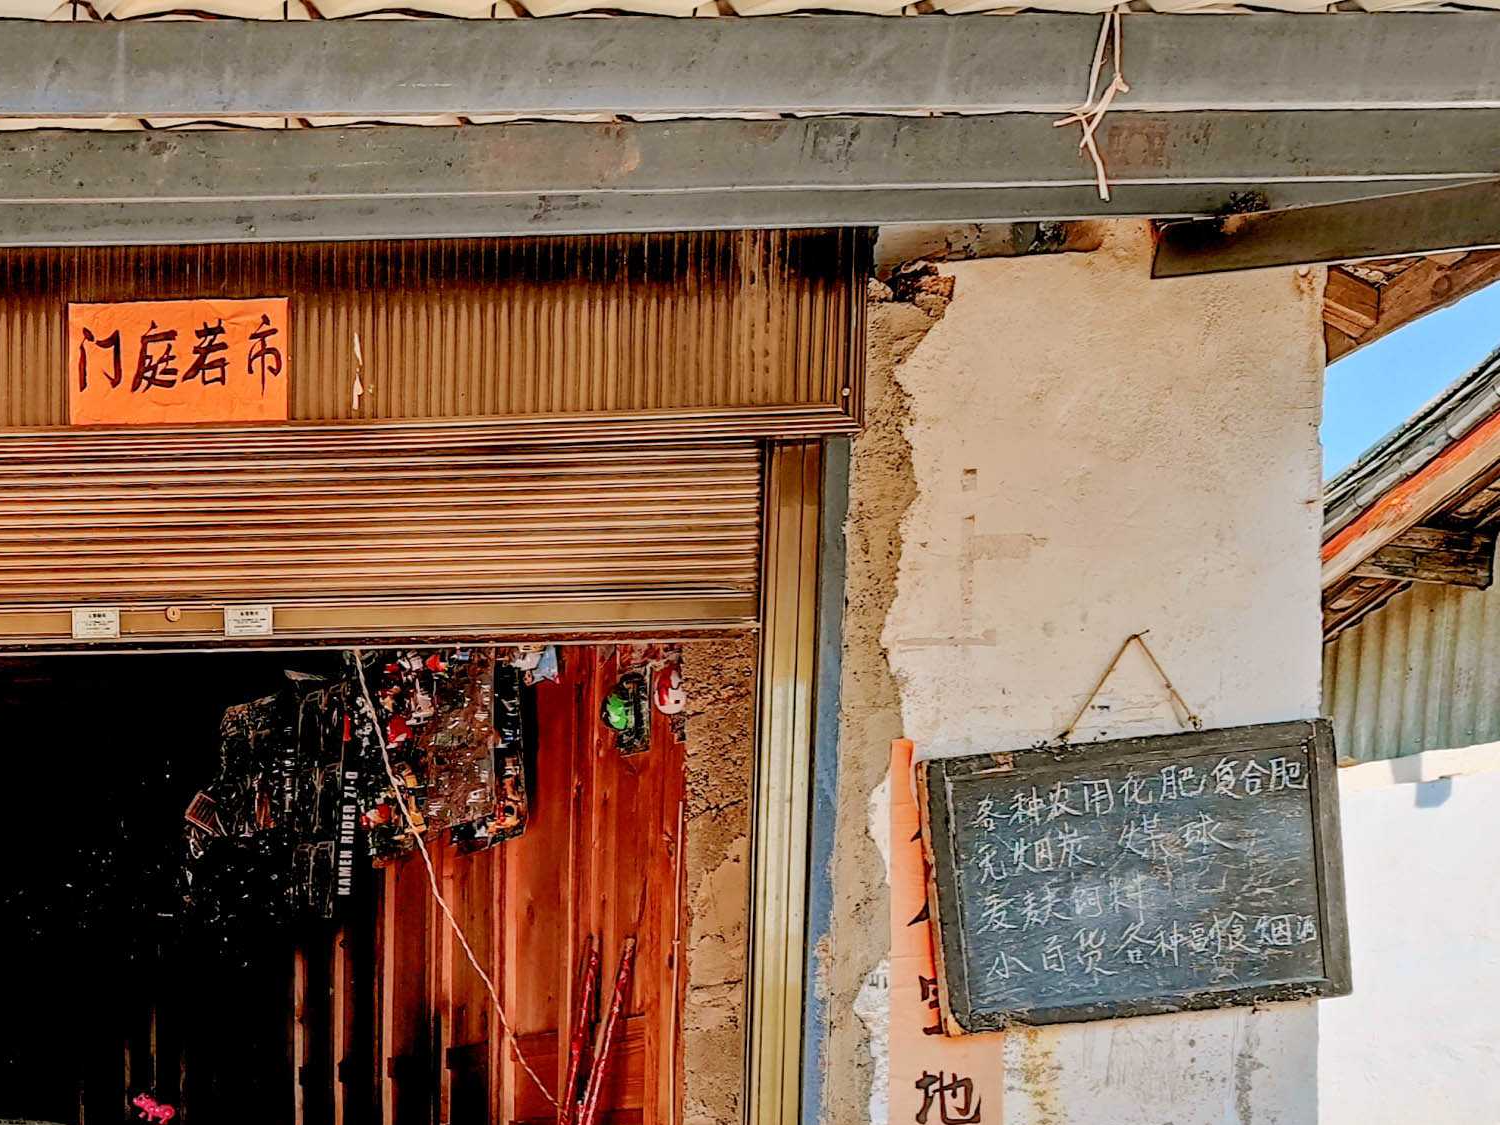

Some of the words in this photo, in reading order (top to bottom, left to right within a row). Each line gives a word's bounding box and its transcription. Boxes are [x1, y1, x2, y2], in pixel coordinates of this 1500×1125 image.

[78, 313, 283, 396] 门庭若市
[340, 805, 357, 844] RIDER
[337, 850, 353, 896] KAMEN
